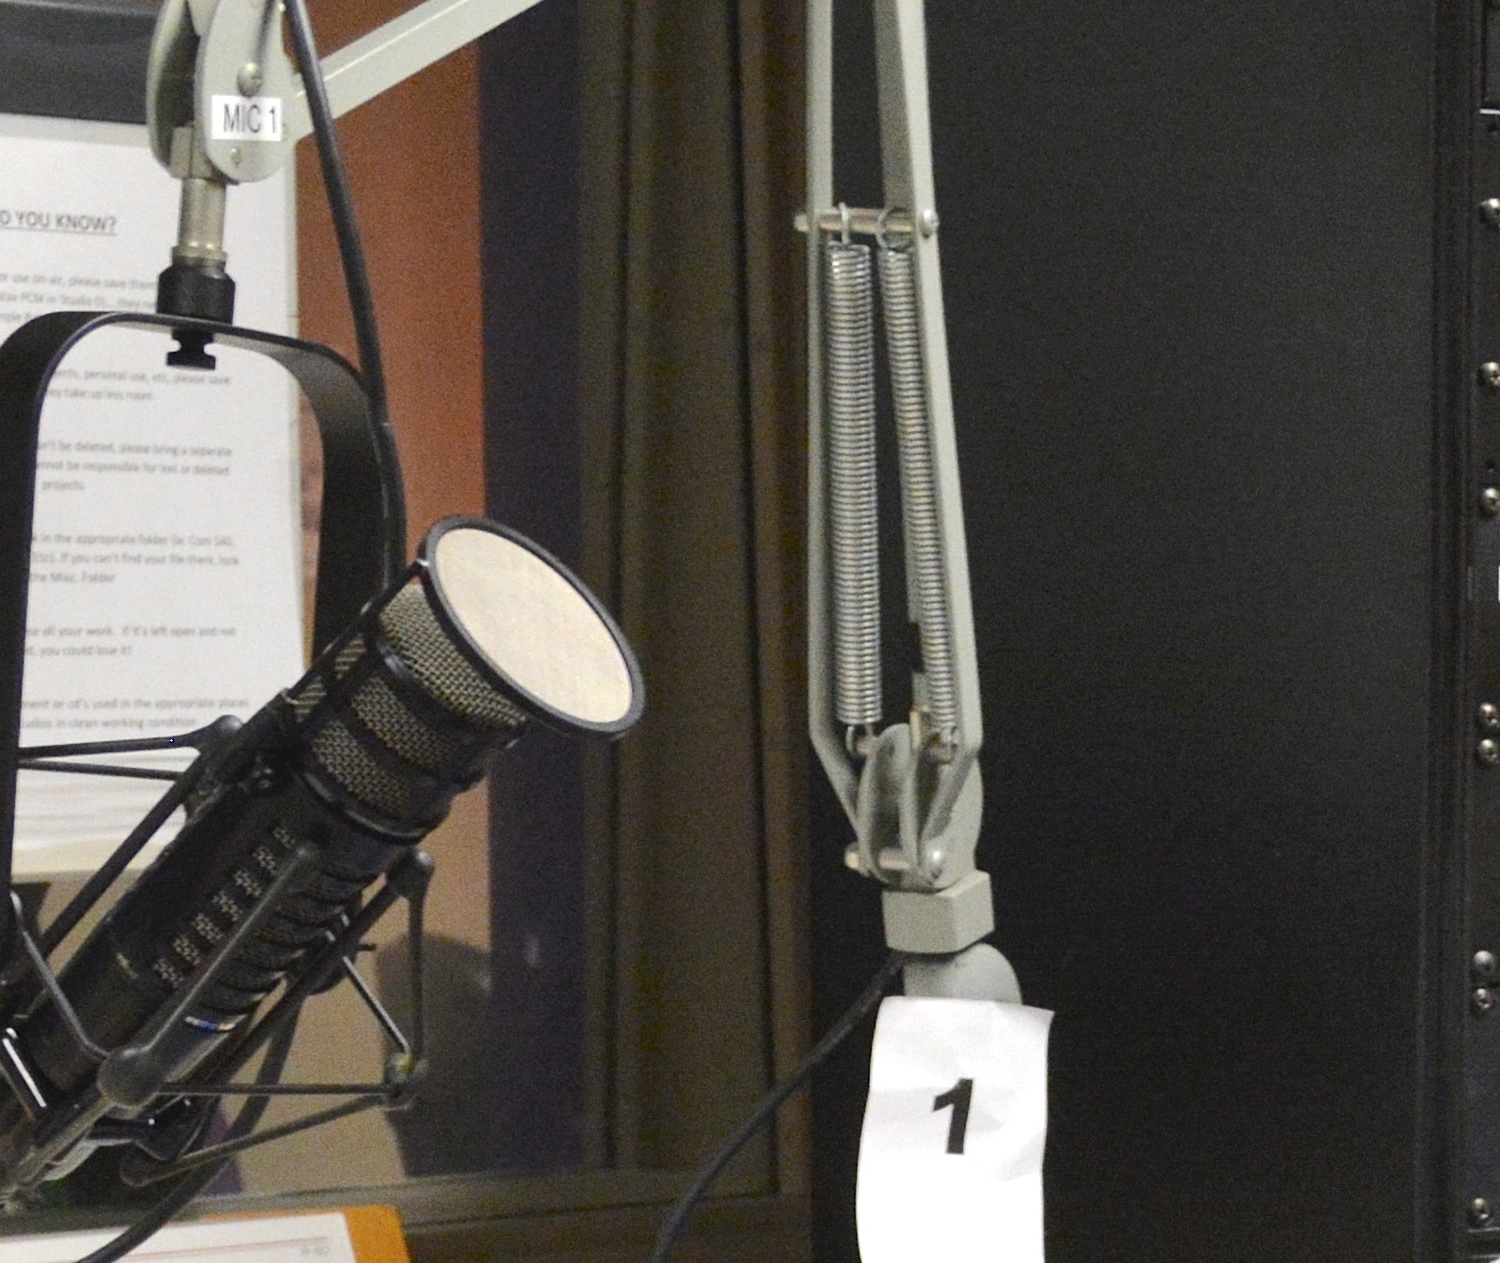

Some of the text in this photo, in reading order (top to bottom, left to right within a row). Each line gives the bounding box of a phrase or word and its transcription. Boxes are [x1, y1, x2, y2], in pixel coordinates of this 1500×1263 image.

[223, 103, 280, 133] MIC 1
[16, 211, 51, 230] YOU
[55, 214, 119, 234] KNOW?
[932, 1077, 975, 1155] 1
